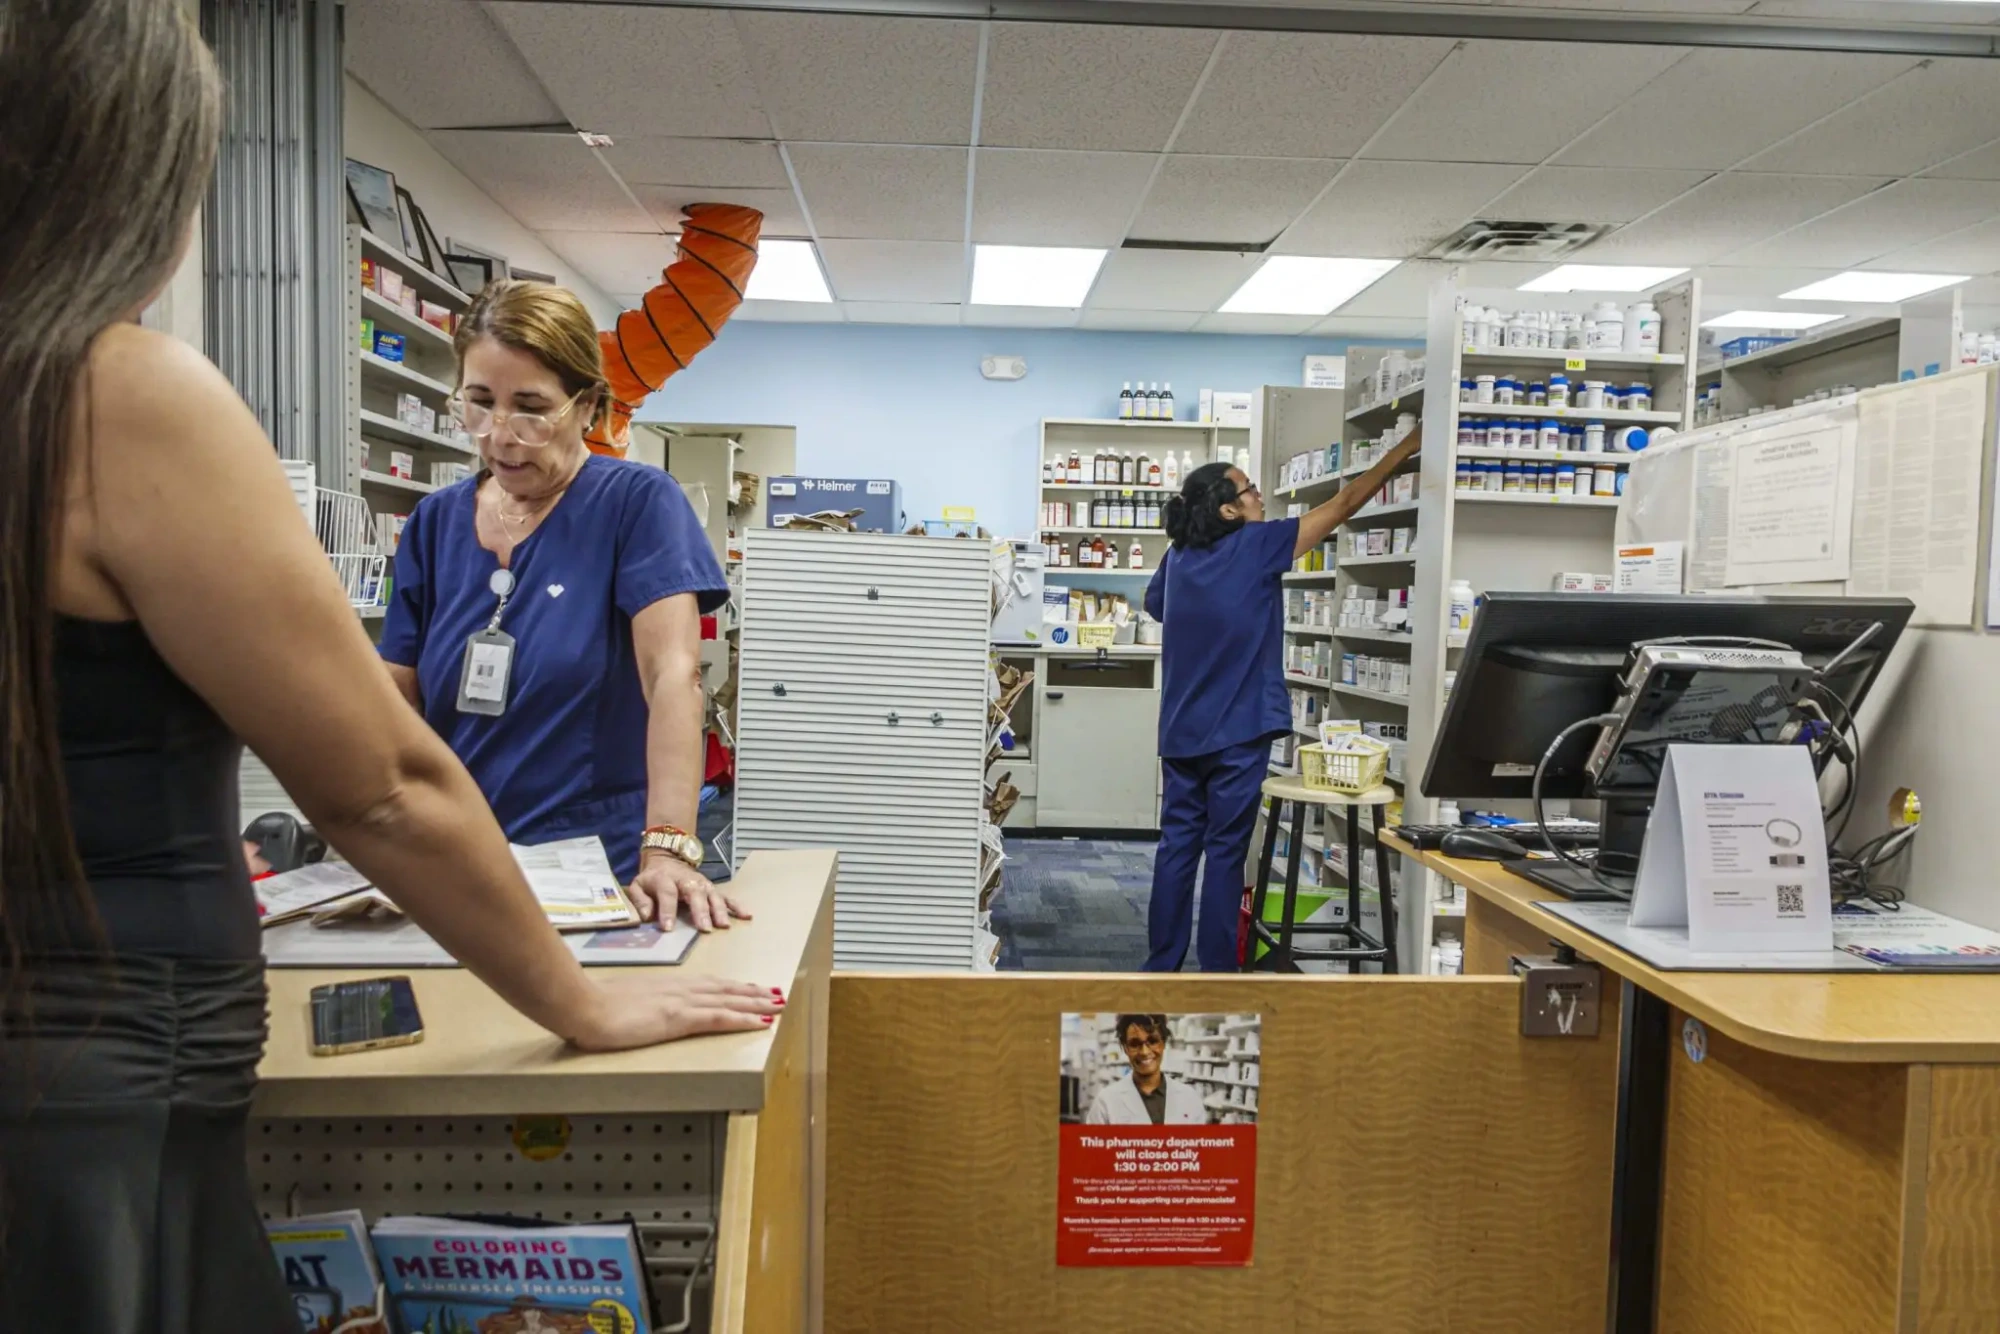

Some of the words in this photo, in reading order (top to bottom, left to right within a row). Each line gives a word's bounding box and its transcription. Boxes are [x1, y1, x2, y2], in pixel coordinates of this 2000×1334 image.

[817, 480, 856, 492] Helmer
[1080, 1136, 1104, 1147] This
[1106, 1136, 1164, 1149] pharmacy
[1166, 1136, 1234, 1149] department
[1116, 1149, 1136, 1159] will
[1138, 1149, 1169, 1159] close
[1171, 1149, 1199, 1161] daily
[1114, 1162, 1137, 1172] 1:30
[1139, 1162, 1151, 1172] to
[1153, 1162, 1179, 1172] 2:00
[1181, 1162, 1200, 1172] PM
[1075, 1196, 1100, 1204] Thank
[1116, 1196, 1127, 1204] for
[1128, 1196, 1170, 1205] supporting
[433, 1239, 567, 1255] COLORING
[391, 1256, 624, 1282] MERMAIDS
[421, 1282, 516, 1294] UNDERSEA
[521, 1283, 625, 1297] TREASURES
